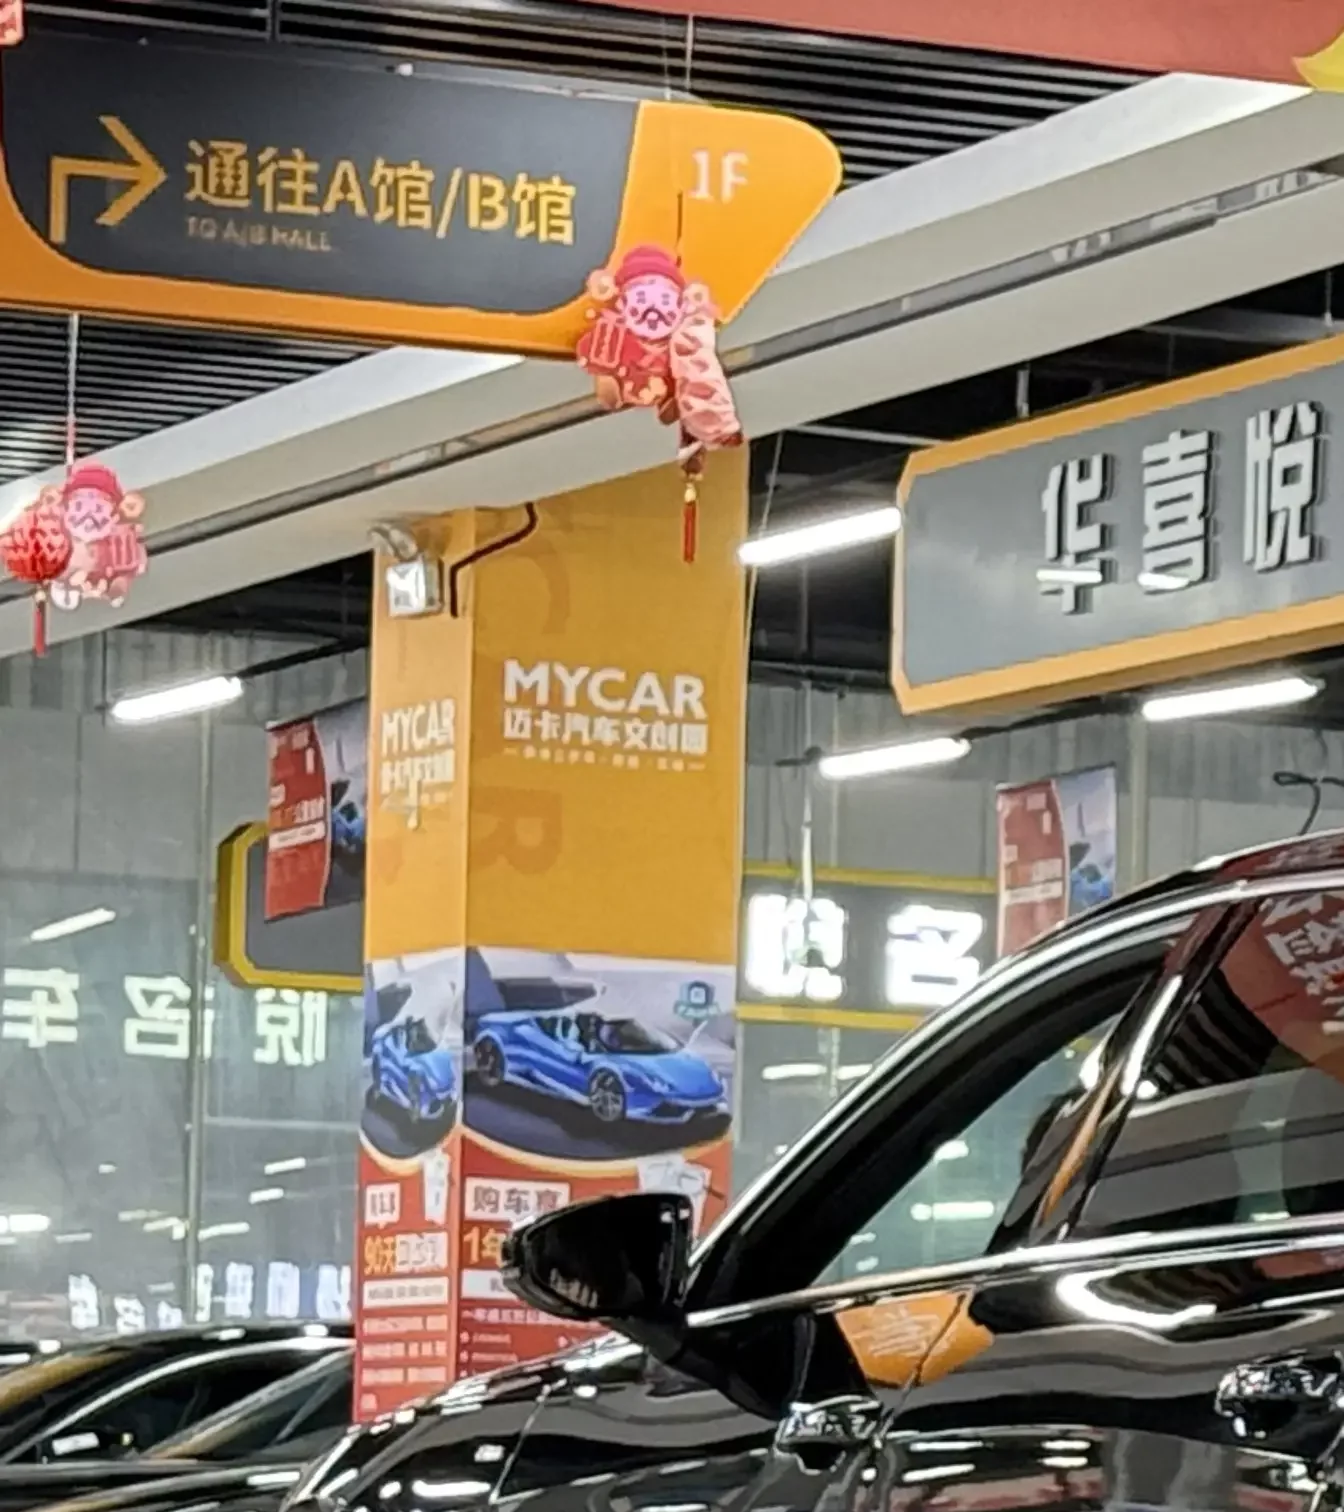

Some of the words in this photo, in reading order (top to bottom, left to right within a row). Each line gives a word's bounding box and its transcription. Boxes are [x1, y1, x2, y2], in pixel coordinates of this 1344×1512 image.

[184, 139, 578, 246] 通往A馆/B馆
[691, 150, 748, 201] 1F
[502, 657, 710, 722] MYCAR
